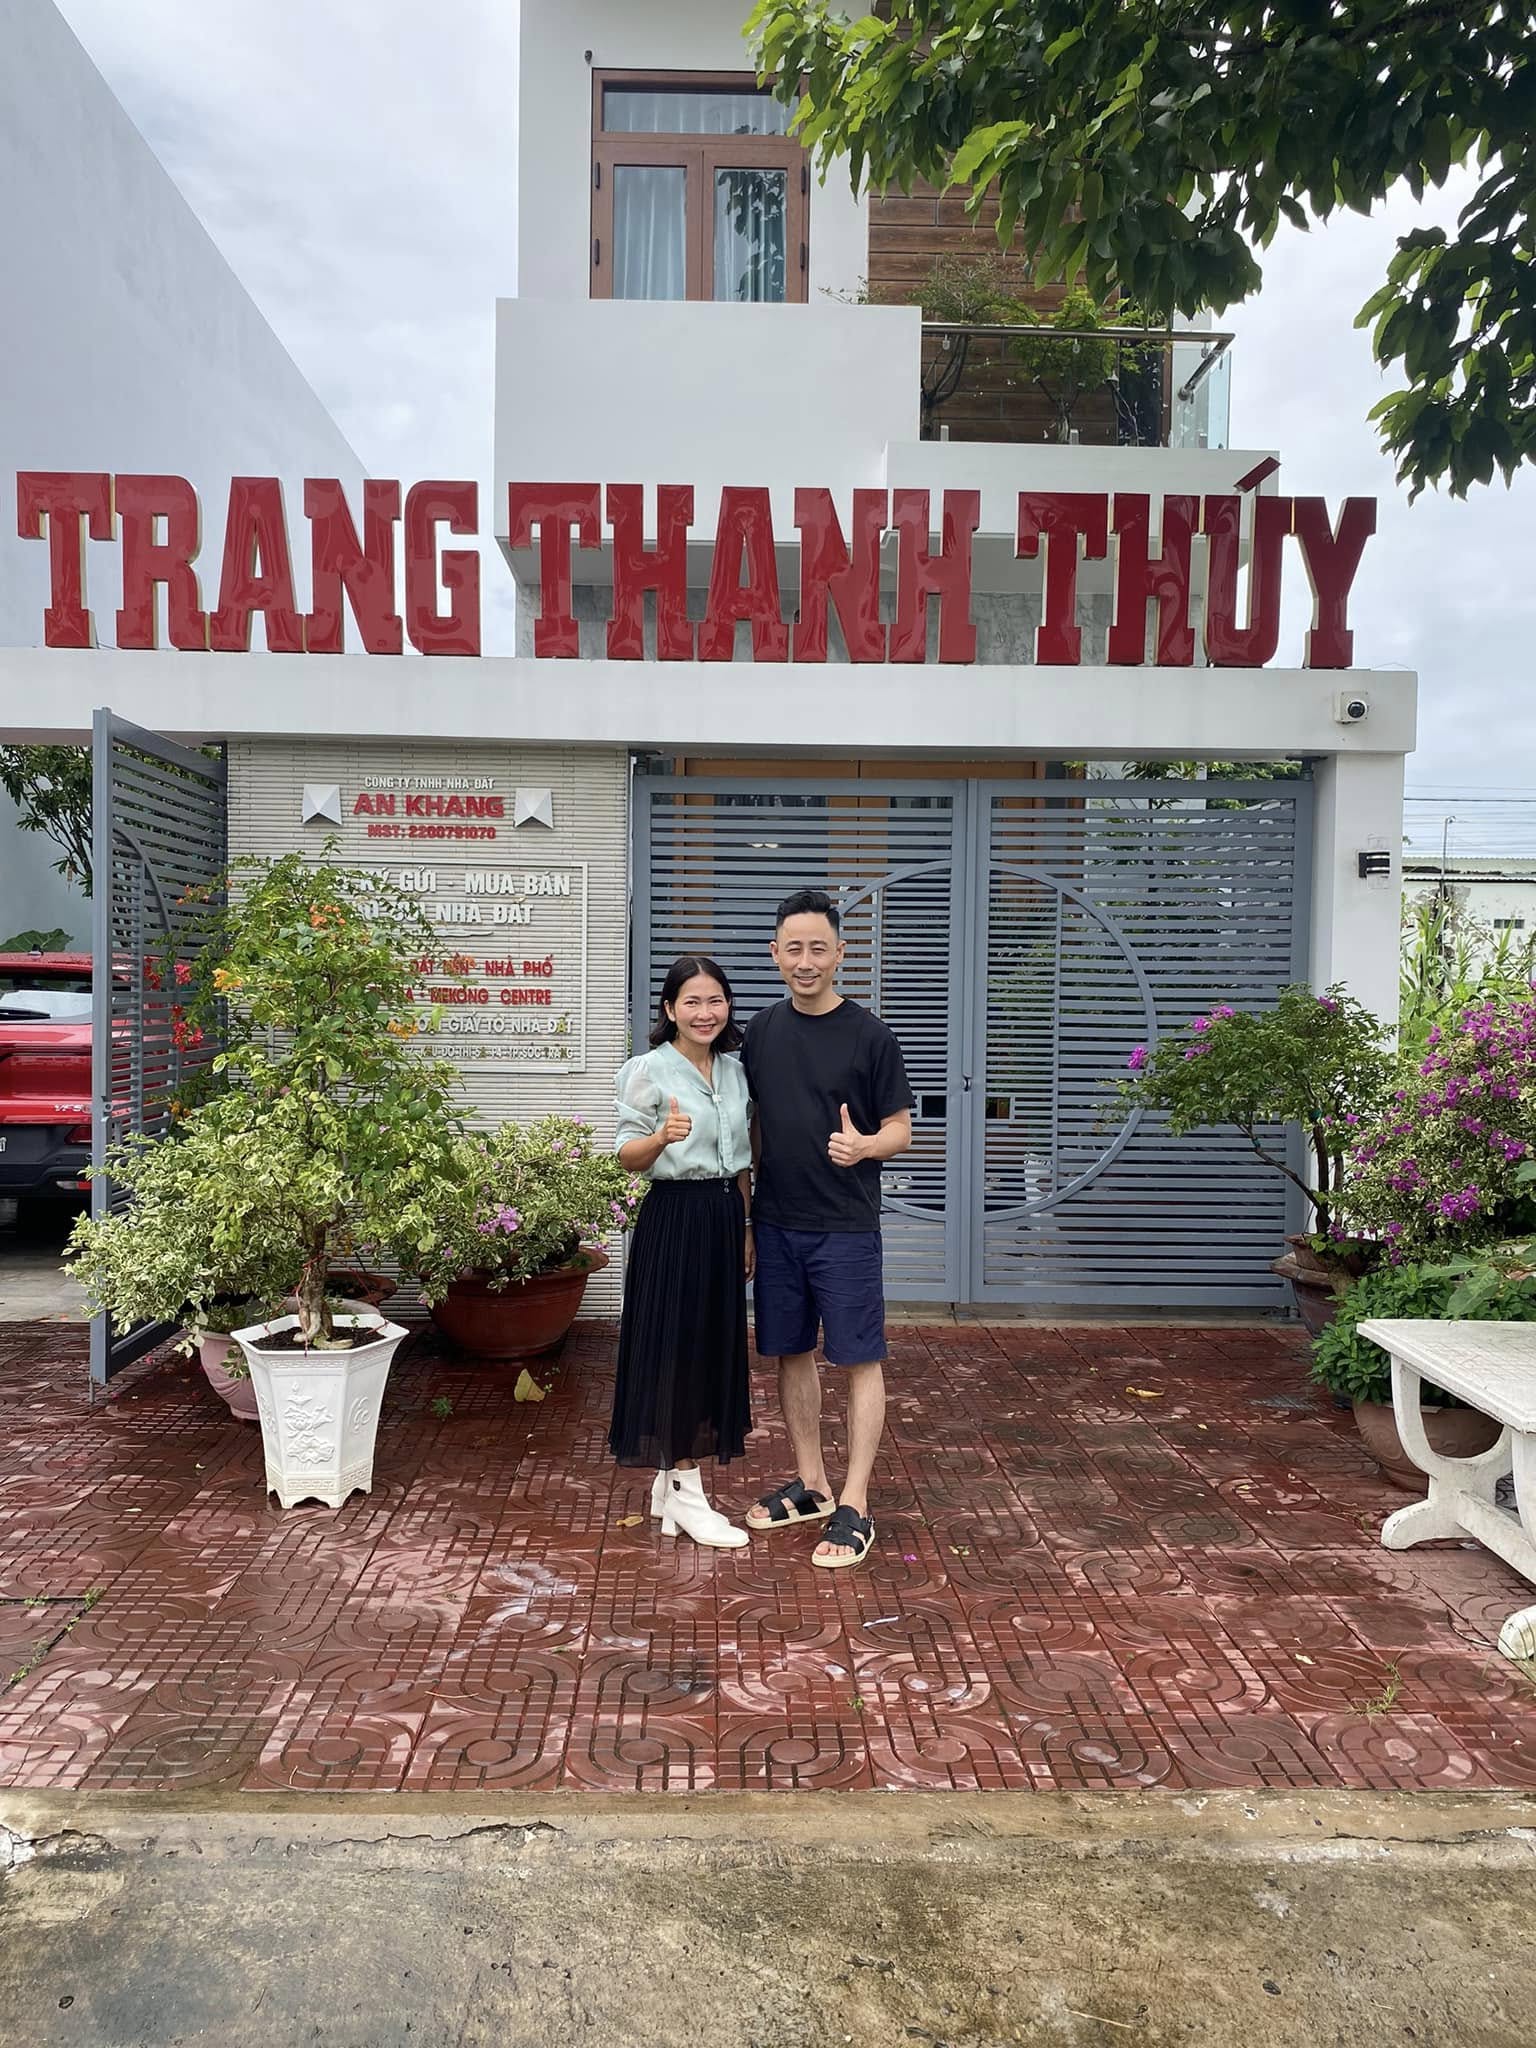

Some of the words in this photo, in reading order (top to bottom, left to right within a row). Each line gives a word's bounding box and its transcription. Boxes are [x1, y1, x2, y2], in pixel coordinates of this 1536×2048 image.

[16, 471, 482, 656] TRANG
[508, 481, 981, 664] THANH
[1014, 456, 1377, 669] THÚY
[397, 777, 410, 788] TY
[414, 777, 442, 789] TNHH
[354, 793, 395, 816] AN
[405, 795, 504, 817] KHANG
[400, 865, 437, 893] GỬI
[465, 873, 515, 895] MUA
[524, 871, 570, 896] BÁN
[436, 898, 481, 923] NHÀ
[493, 897, 534, 924] ĐẤT
[523, 953, 554, 977] PHỐ
[431, 986, 489, 1004] MEKONG
[501, 988, 552, 1005] CENTRE
[449, 1008, 480, 1033] GIẤY
